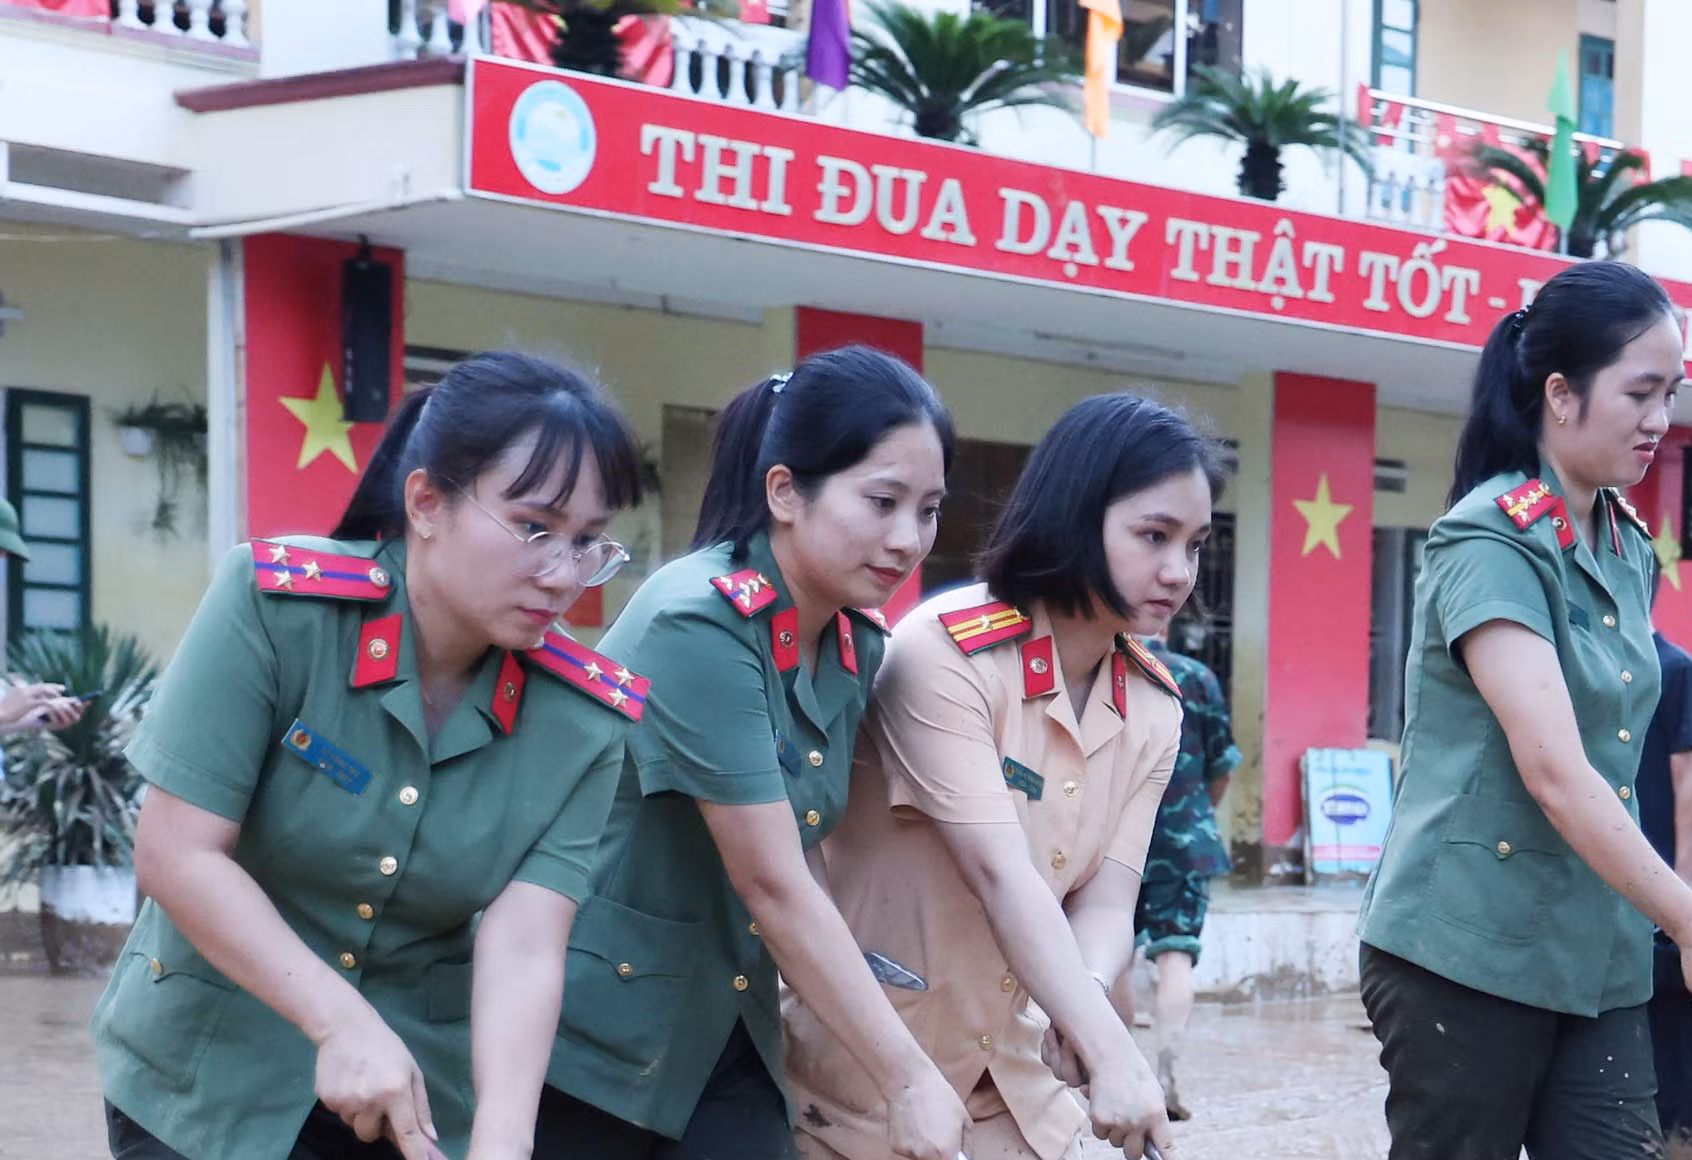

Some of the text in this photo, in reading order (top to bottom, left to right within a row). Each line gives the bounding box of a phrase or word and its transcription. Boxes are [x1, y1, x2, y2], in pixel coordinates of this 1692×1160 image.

[640, 123, 795, 216] THI
[814, 155, 977, 247] ĐUA
[996, 187, 1149, 278] DẠY
[1165, 217, 1345, 310] THẬT
[1359, 238, 1480, 325] TỐT
